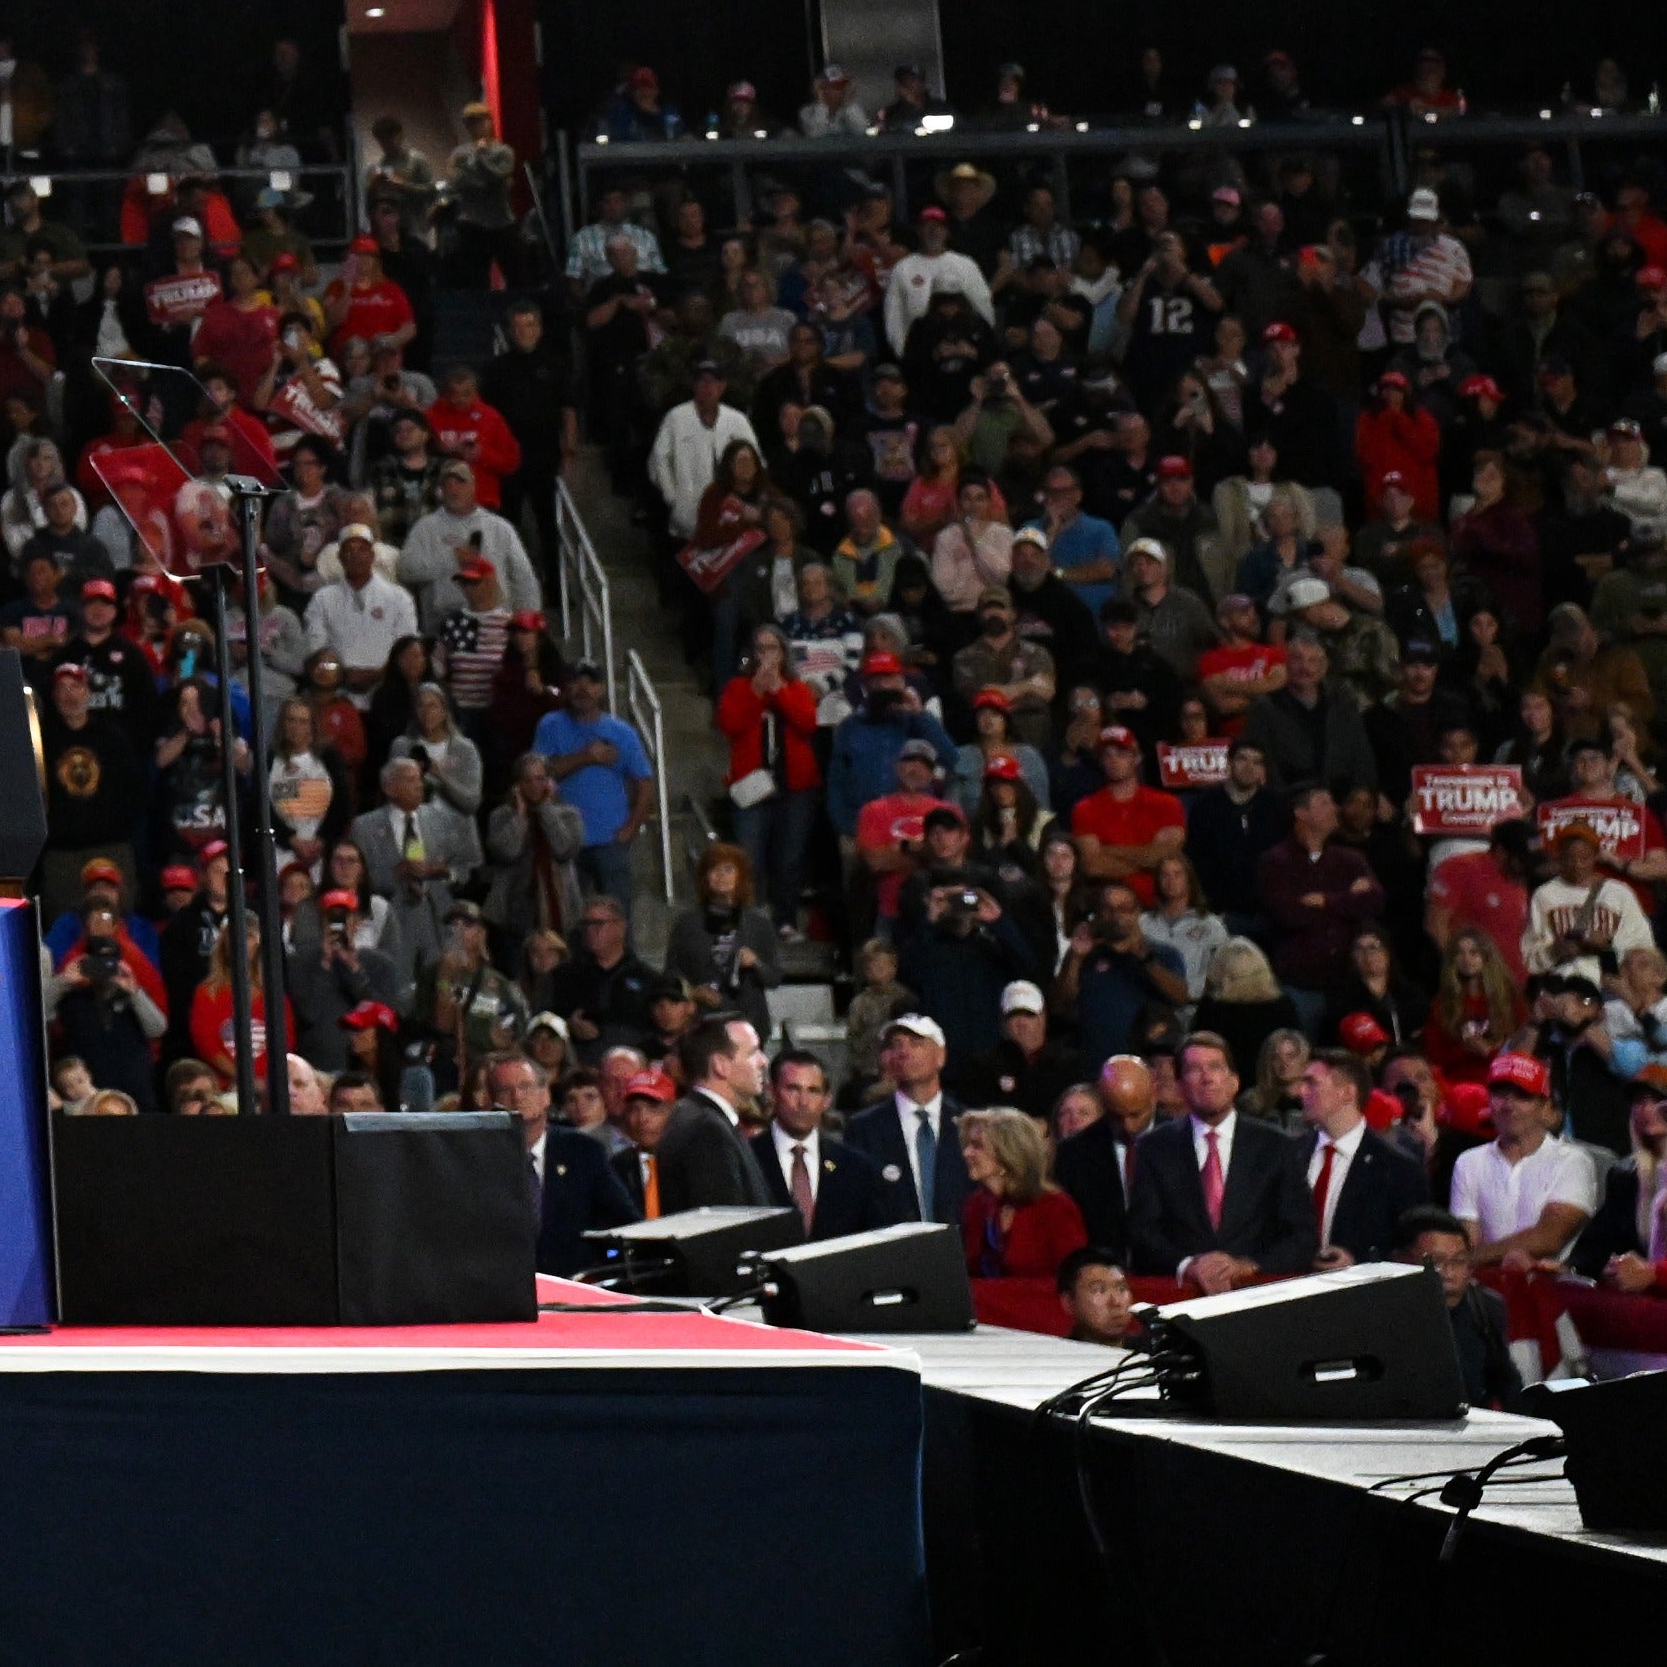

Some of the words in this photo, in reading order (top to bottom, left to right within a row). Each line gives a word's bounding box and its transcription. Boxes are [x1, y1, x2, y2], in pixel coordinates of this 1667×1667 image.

[1149, 296, 1194, 334] 12
[1163, 755, 1227, 774] TRU
[1418, 787, 1517, 811] TRUMP
[1540, 819, 1640, 841] TMP
